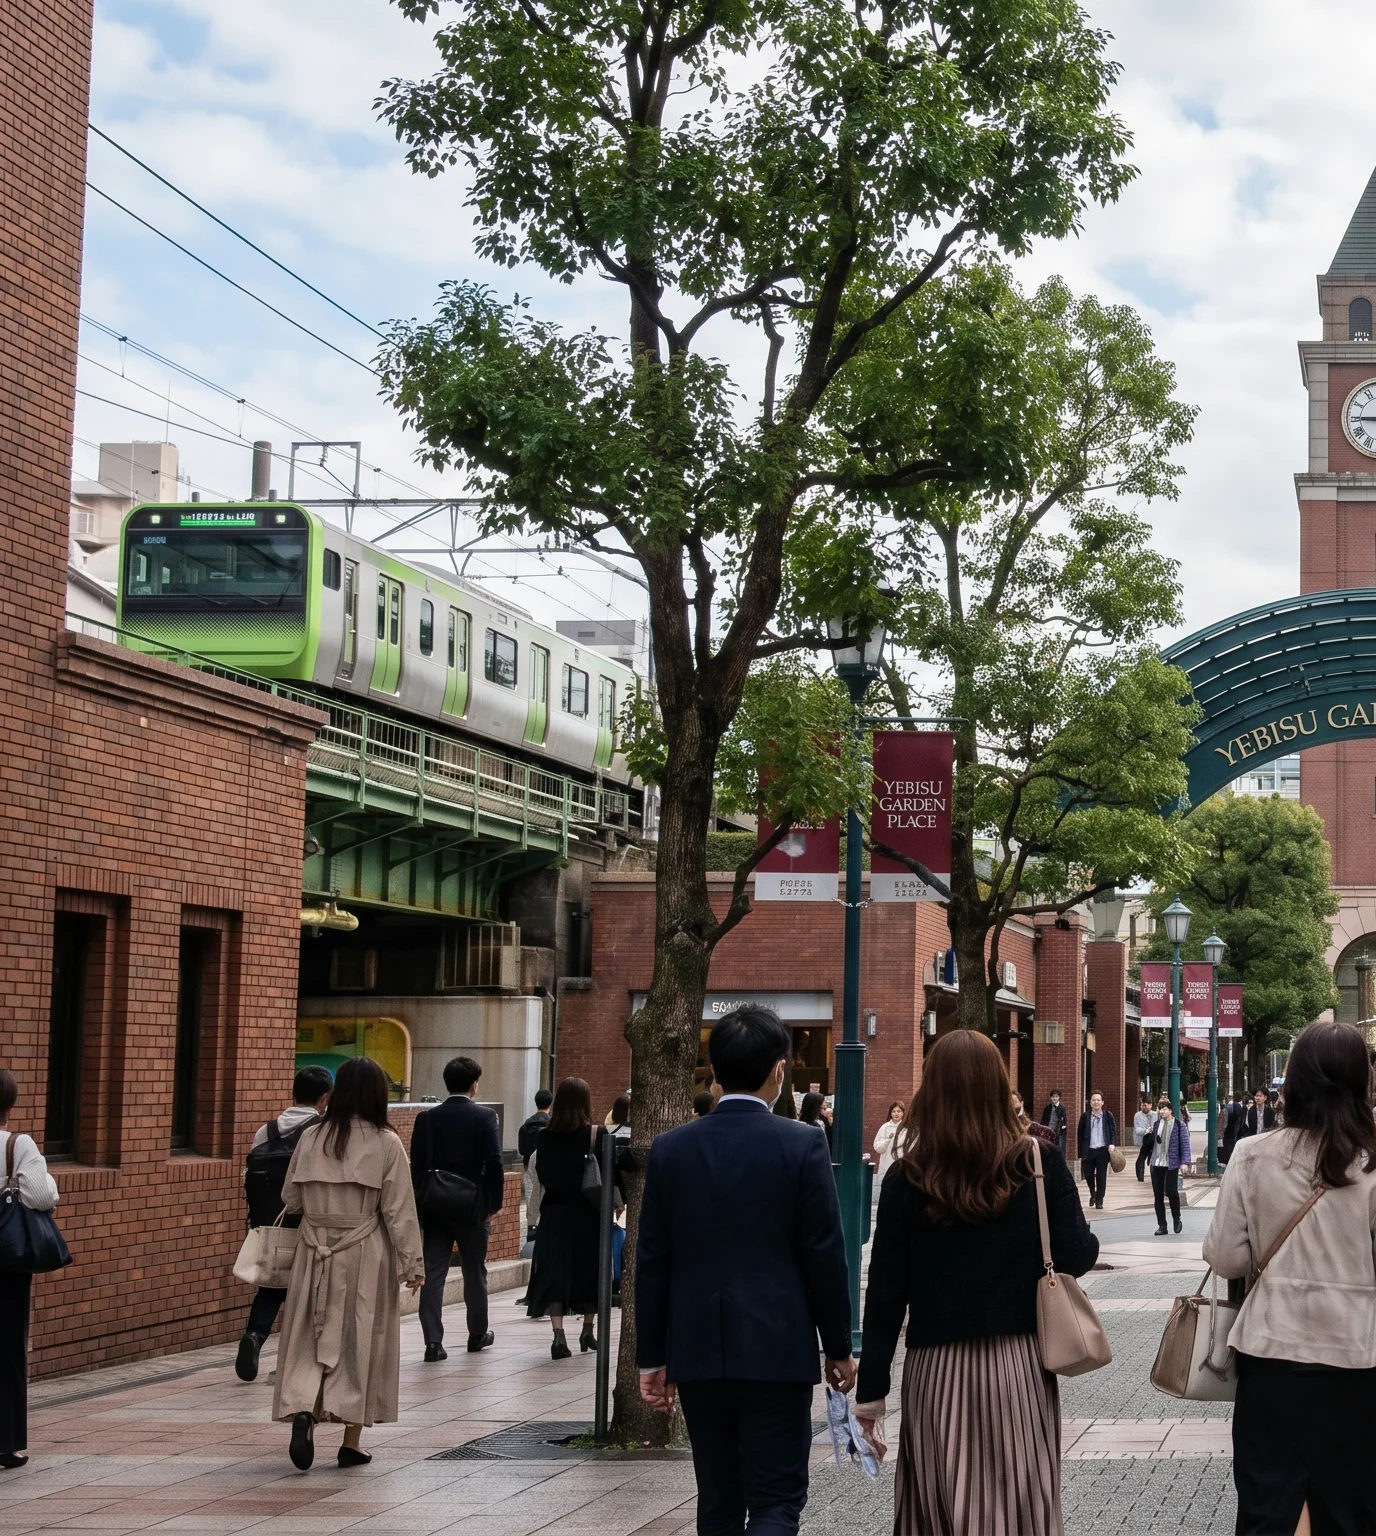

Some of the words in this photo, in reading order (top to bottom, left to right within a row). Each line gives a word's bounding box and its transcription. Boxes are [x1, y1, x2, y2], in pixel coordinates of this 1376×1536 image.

[1215, 709, 1318, 767] YEBISU
[884, 780, 943, 795] YEBISU
[879, 797, 946, 812] GARDEN
[887, 814, 937, 829] PLACE
